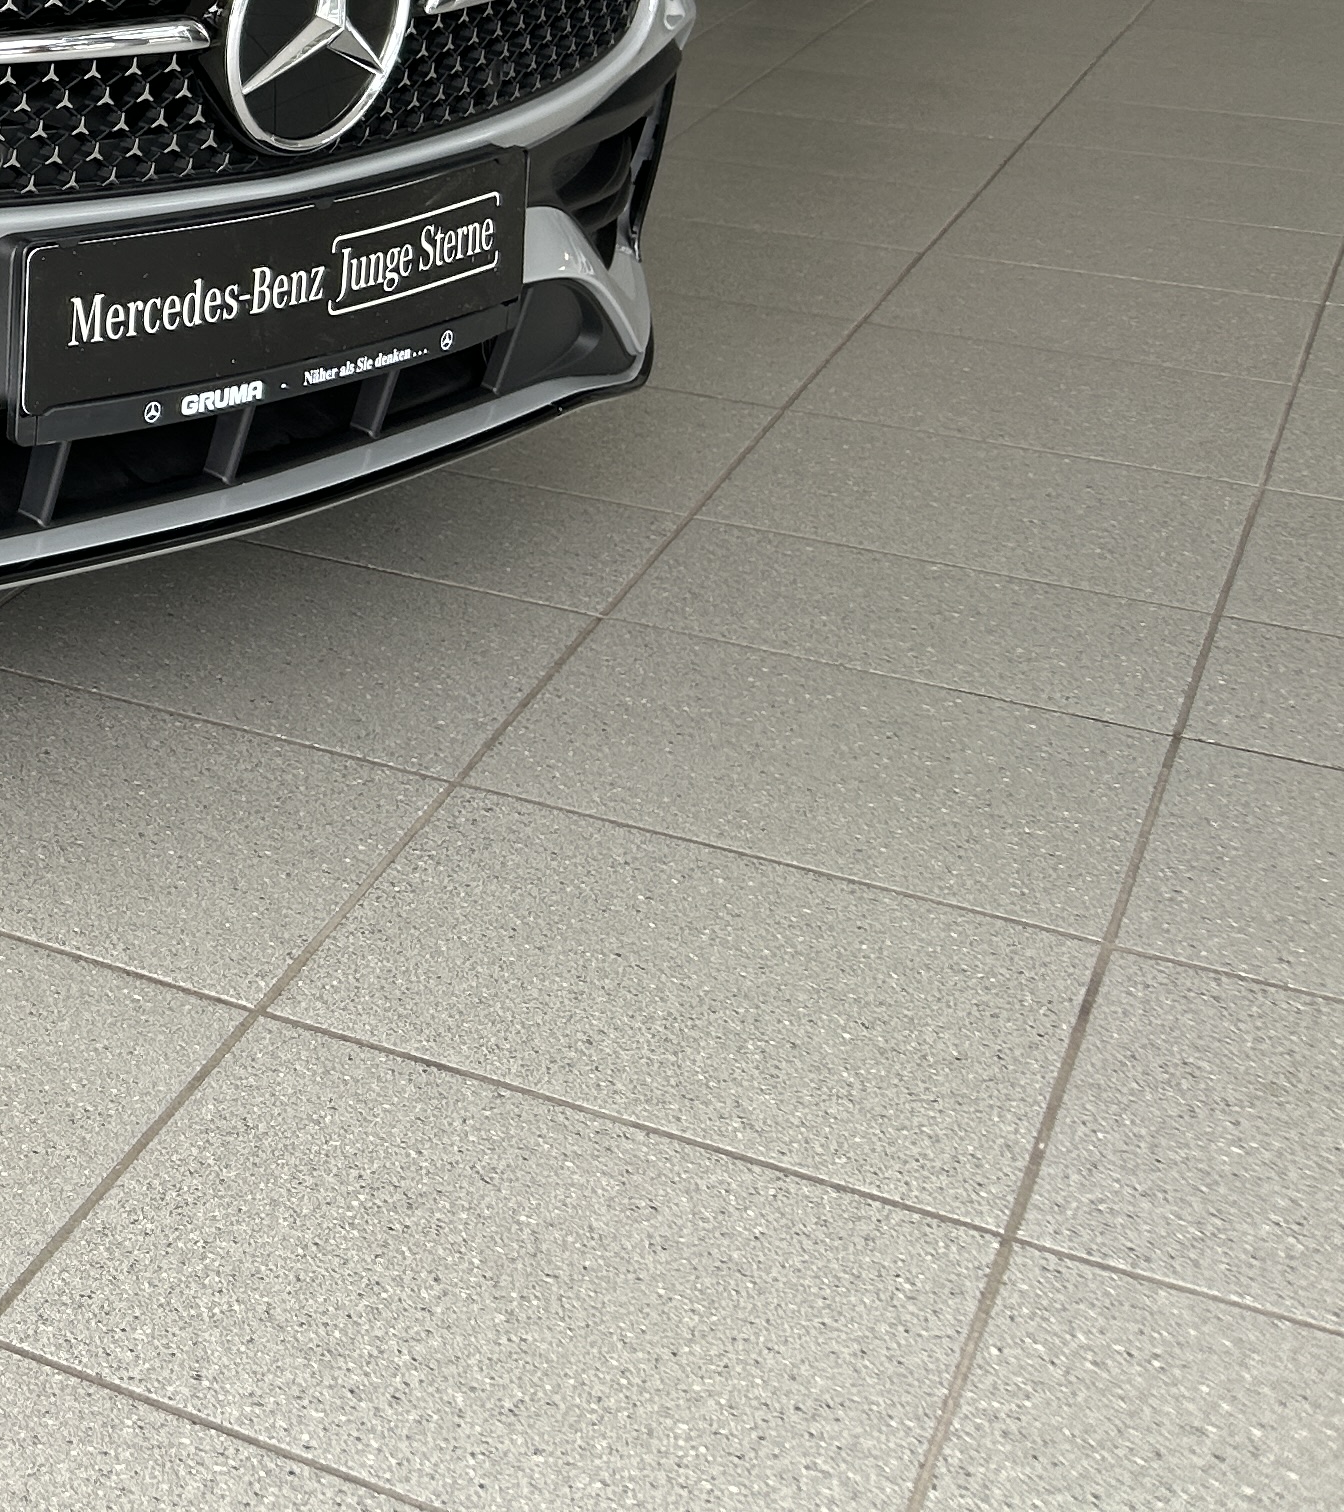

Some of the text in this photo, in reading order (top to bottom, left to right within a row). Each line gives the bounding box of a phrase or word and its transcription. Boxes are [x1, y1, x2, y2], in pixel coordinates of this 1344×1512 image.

[67, 216, 494, 348] Mercedes-Benz Junge Sterne
[180, 380, 263, 417] GRUMA
[303, 366, 338, 387] Näher
[339, 361, 356, 377] als
[356, 355, 373, 374] Sie
